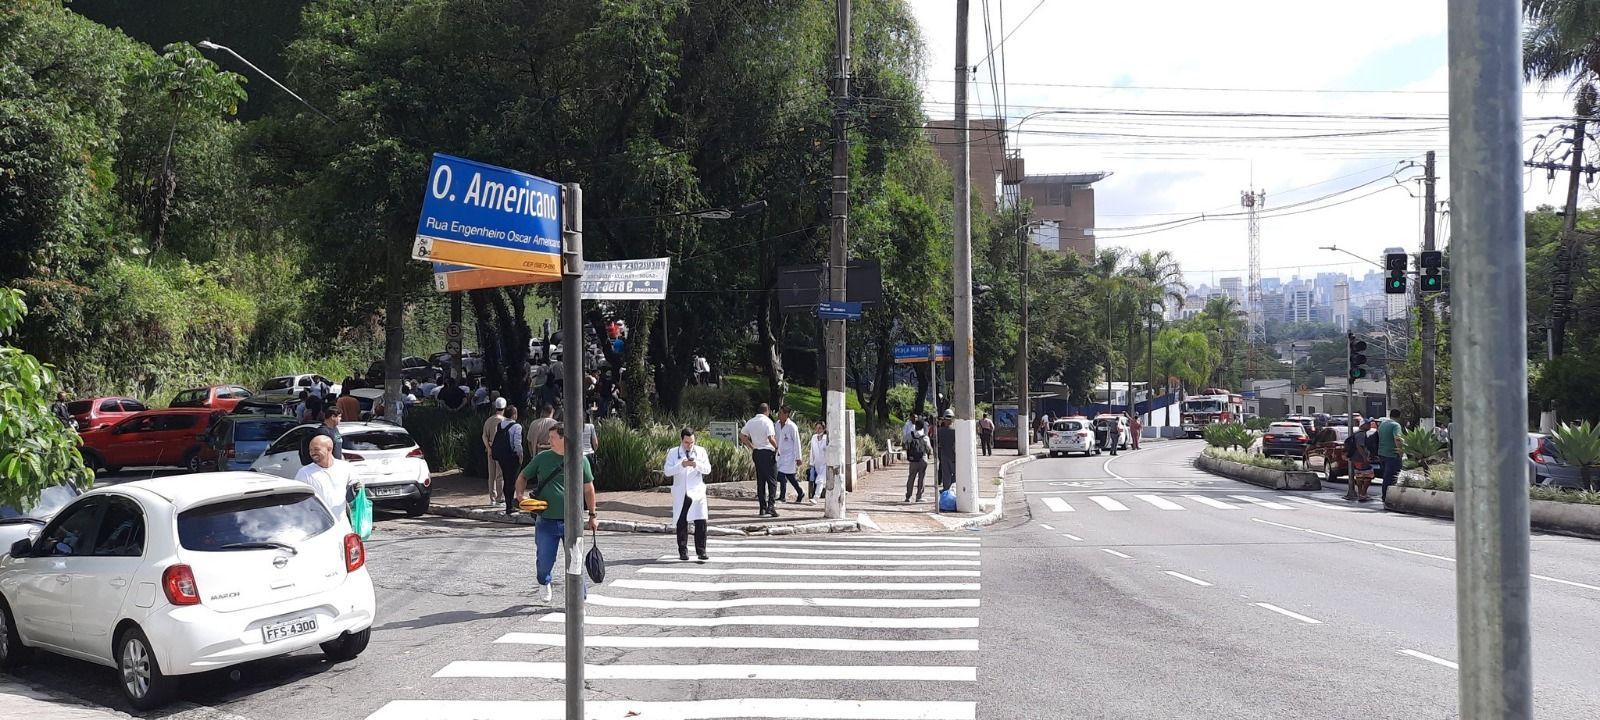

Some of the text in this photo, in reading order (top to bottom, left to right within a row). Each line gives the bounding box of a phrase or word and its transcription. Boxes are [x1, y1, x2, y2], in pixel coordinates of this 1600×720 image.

[433, 164, 557, 220] O. Americano
[426, 217, 448, 232] Rua
[451, 220, 506, 240] Engenheiro
[507, 230, 532, 245] Oscar
